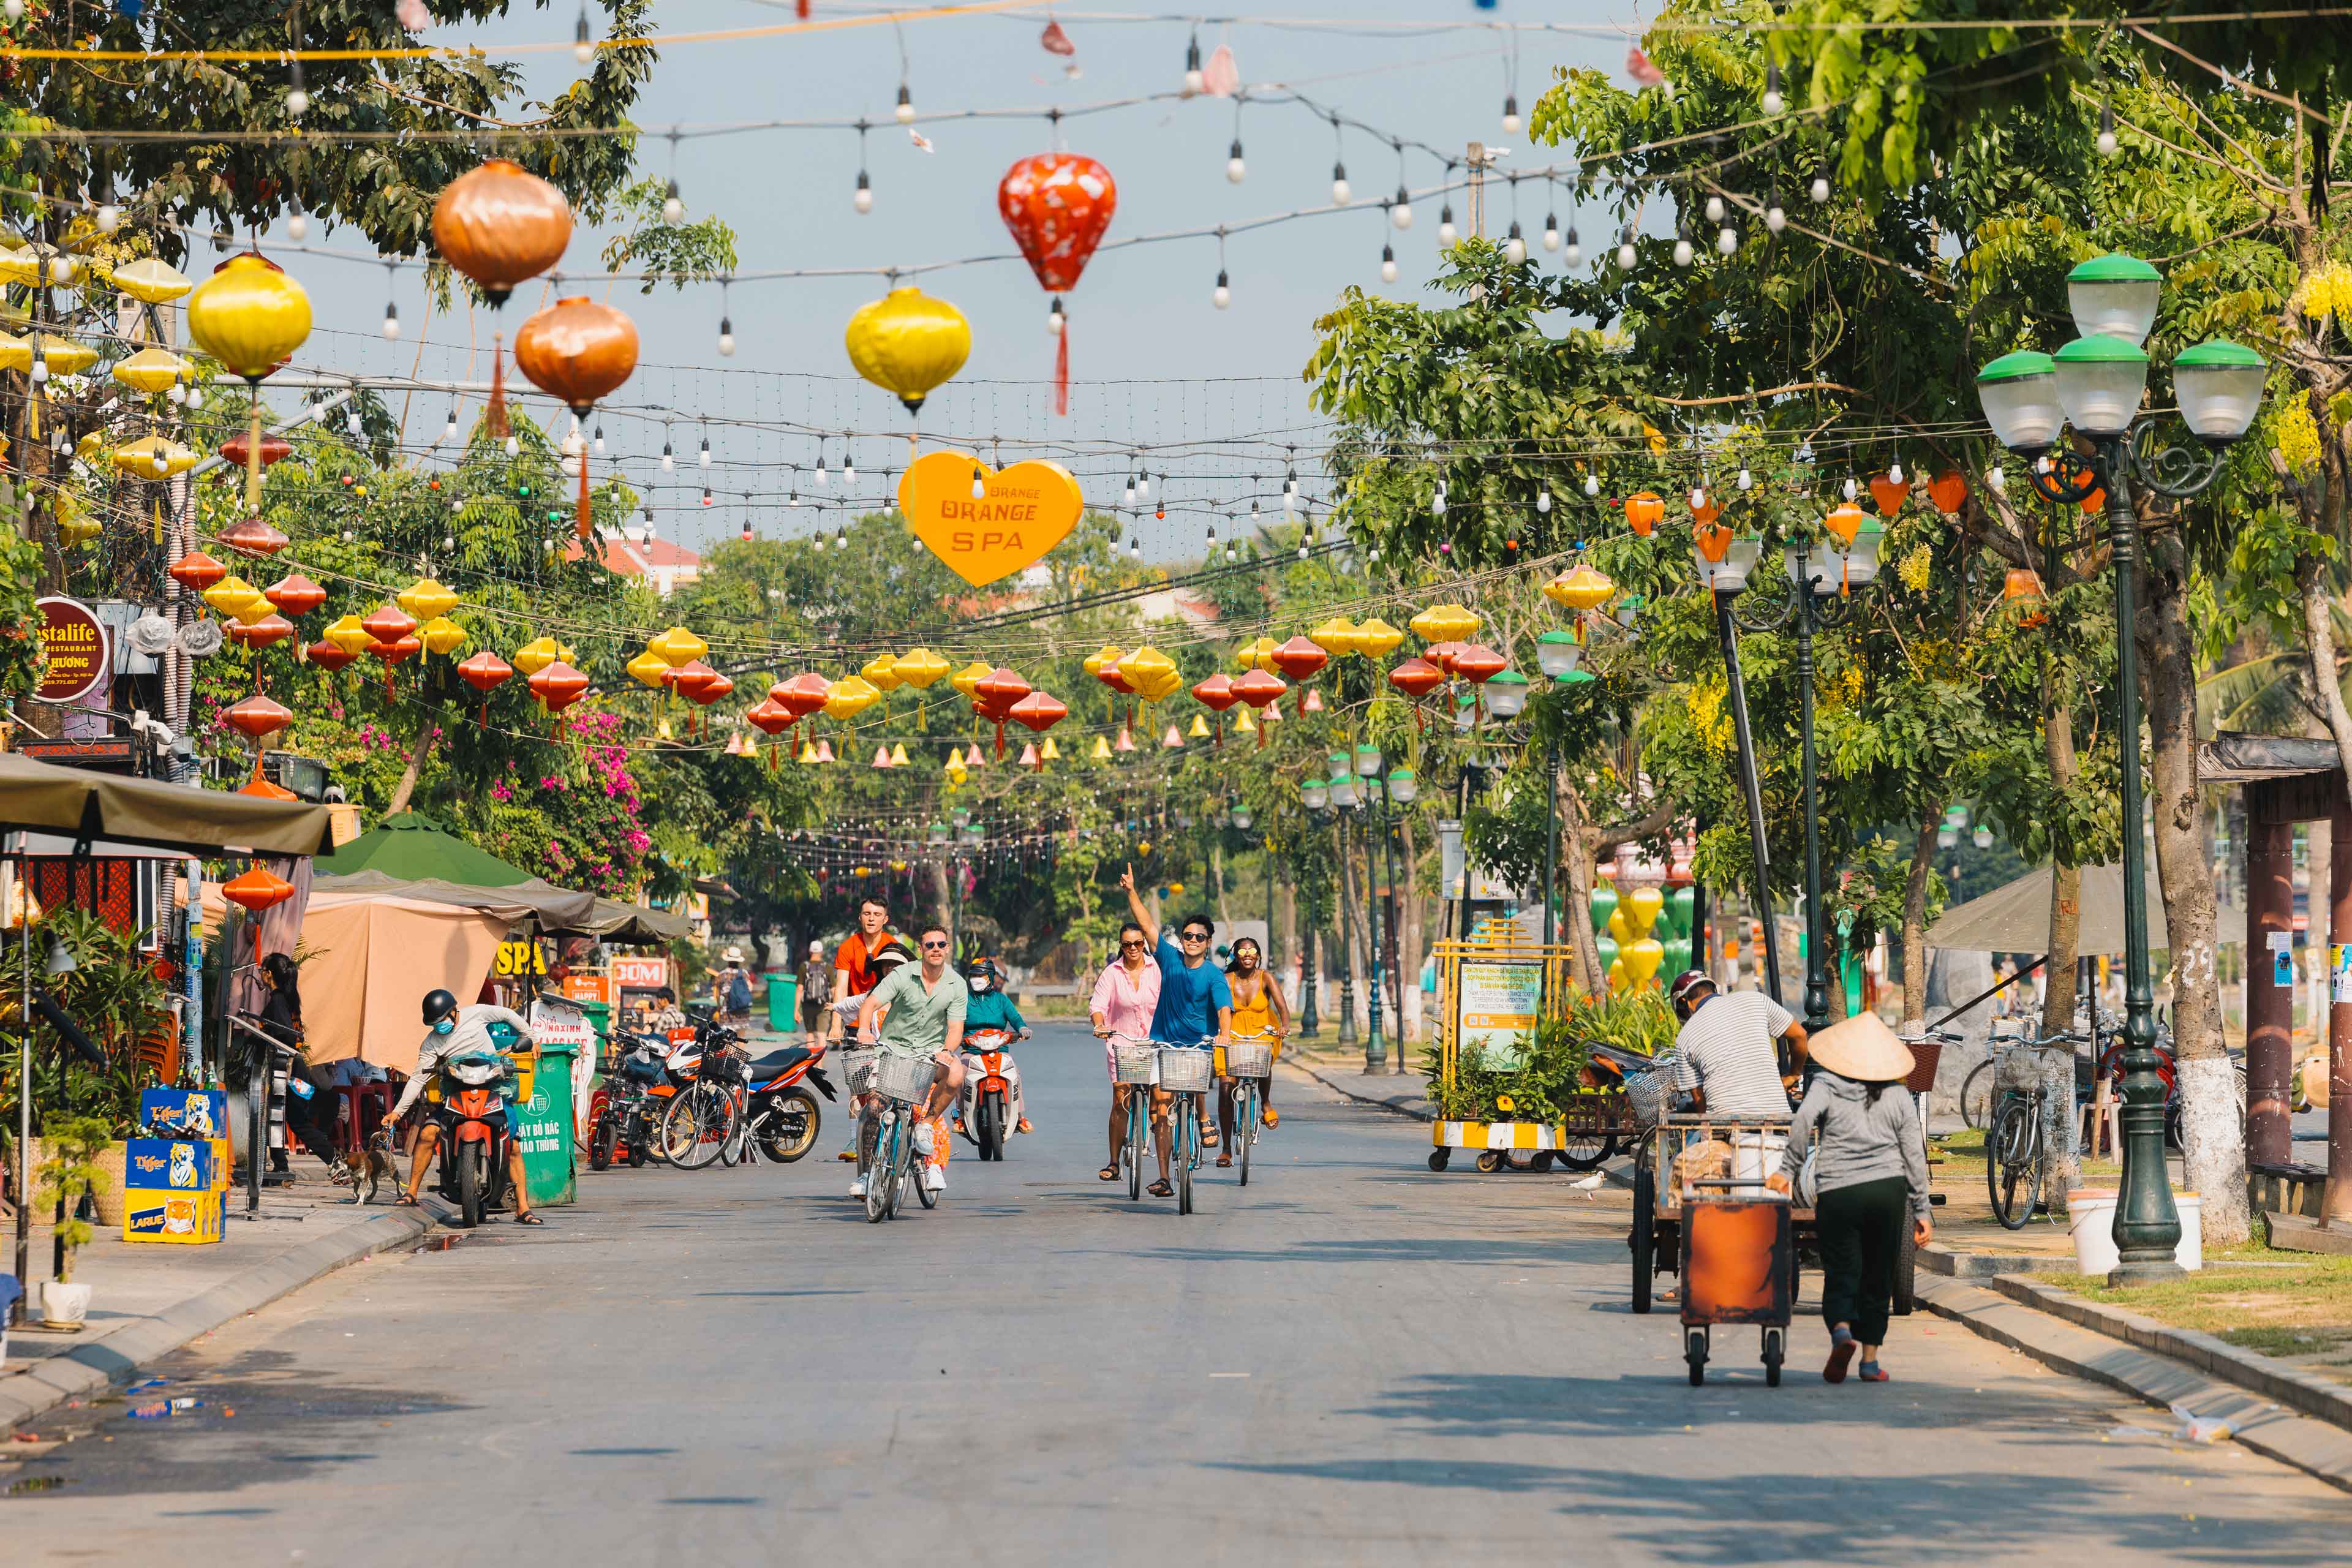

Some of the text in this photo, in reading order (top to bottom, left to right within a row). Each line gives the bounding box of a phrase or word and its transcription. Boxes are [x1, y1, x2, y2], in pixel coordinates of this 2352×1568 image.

[990, 486, 1041, 499] ORANGE
[941, 500, 1038, 522] ORANGE
[951, 532, 1023, 551] SPA
[497, 941, 547, 975] SPA
[150, 1106, 183, 1123] Tger
[545, 1120, 559, 1135] RÁC
[535, 1136, 559, 1152] THÙNG
[134, 1155, 167, 1172] Tiger
[130, 1214, 165, 1230] LARUE
